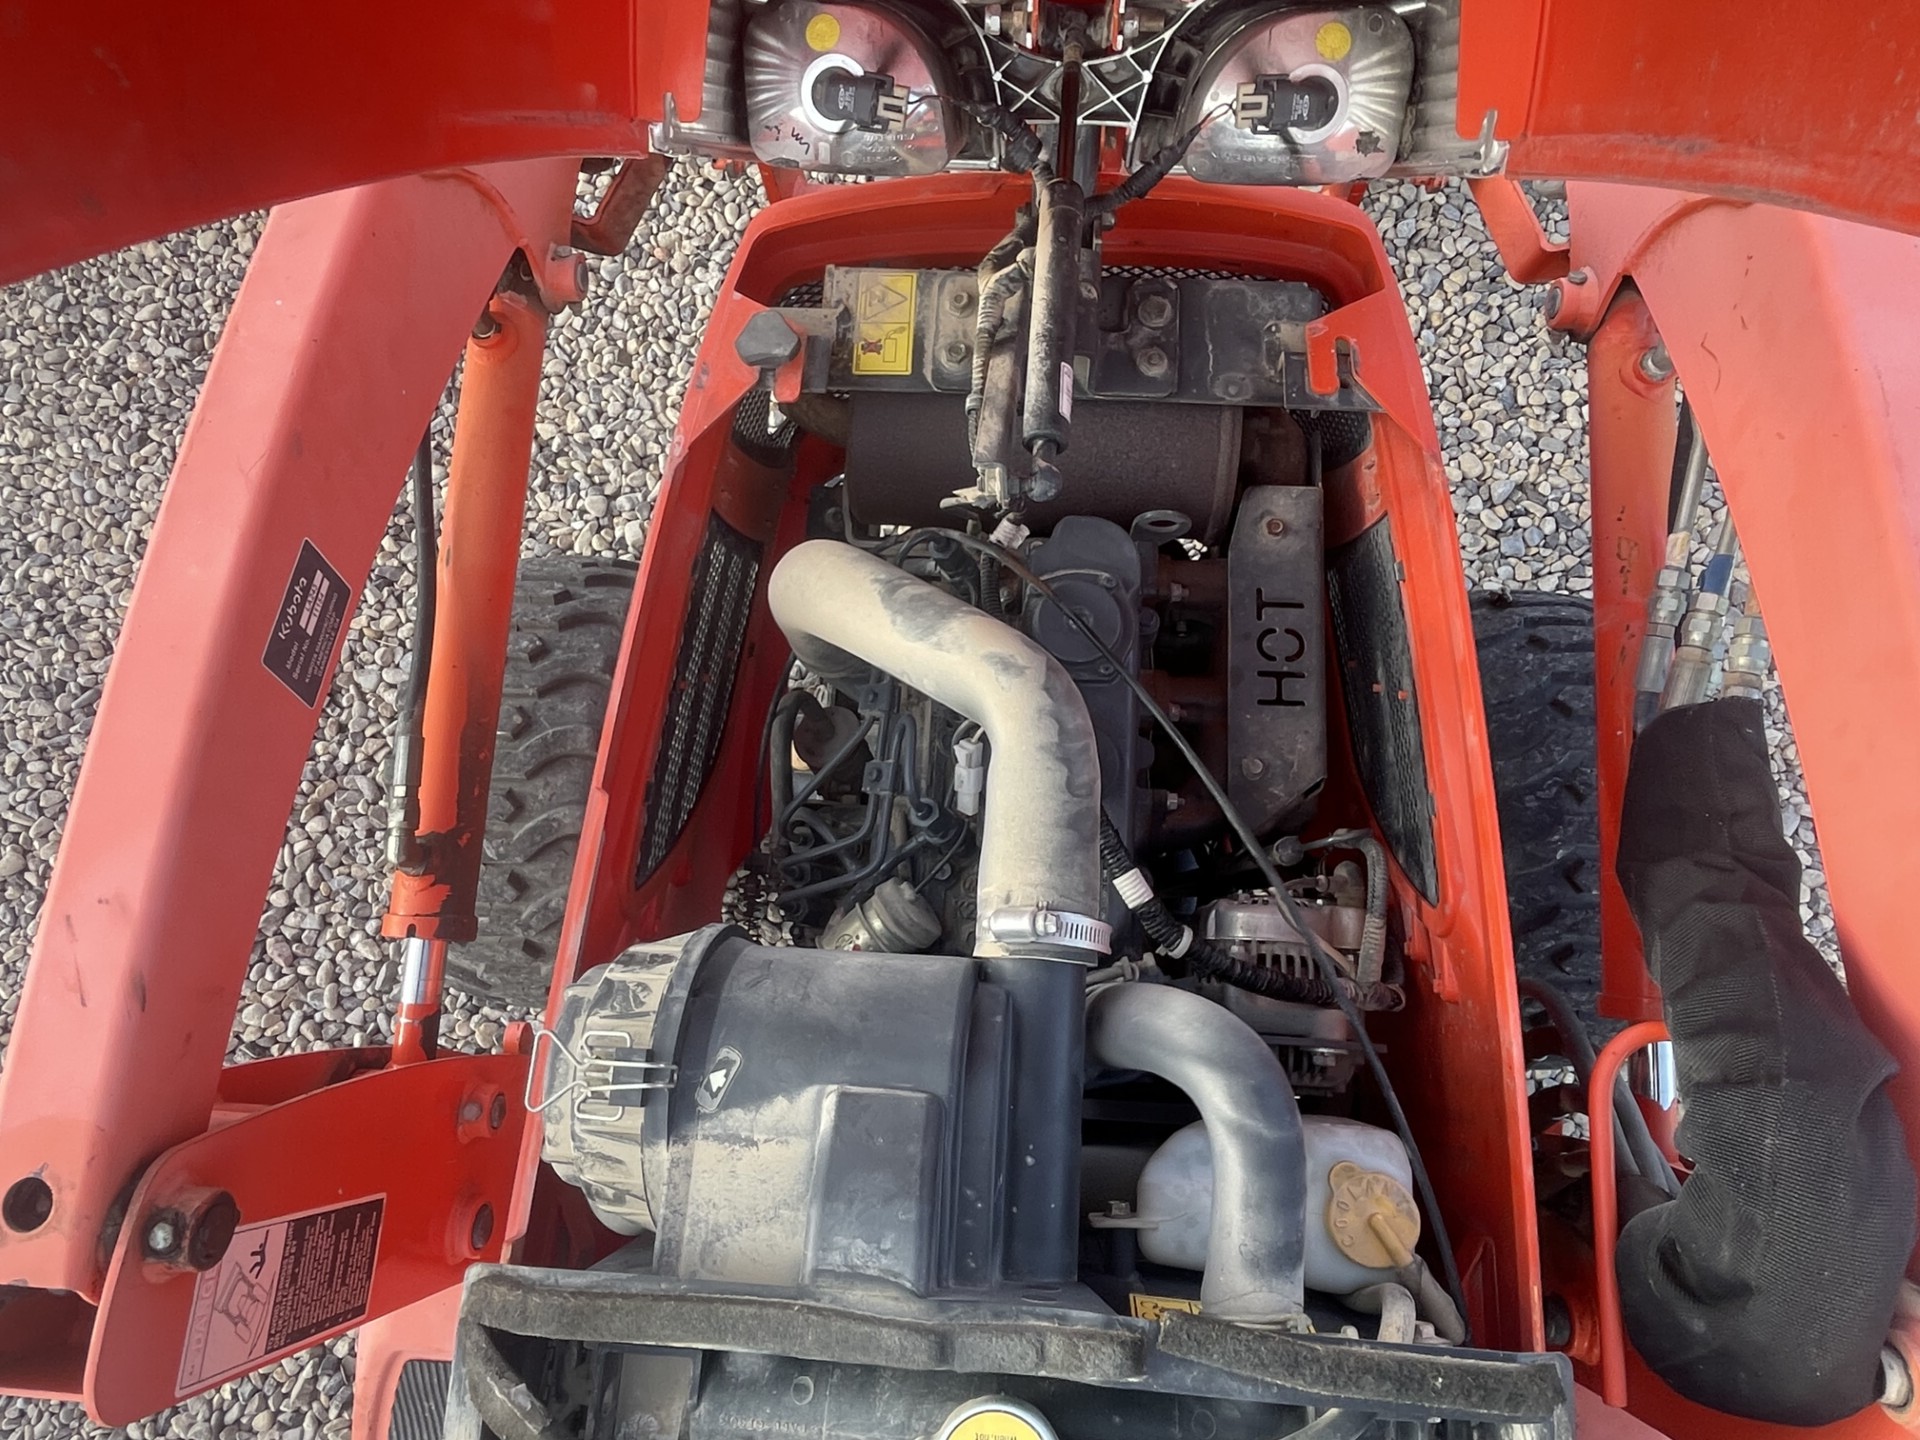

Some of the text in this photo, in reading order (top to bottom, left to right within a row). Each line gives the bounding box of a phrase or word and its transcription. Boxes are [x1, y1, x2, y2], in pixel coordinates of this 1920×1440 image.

[278, 577, 306, 639] Kubota
[285, 641, 298, 669] Model
[292, 652, 304, 679] Serial
[1256, 587, 1307, 706] HOT
[270, 1304, 279, 1333] AVOID
[275, 1258, 288, 1302] SERIOUS
[276, 1297, 287, 1330] DEATH
